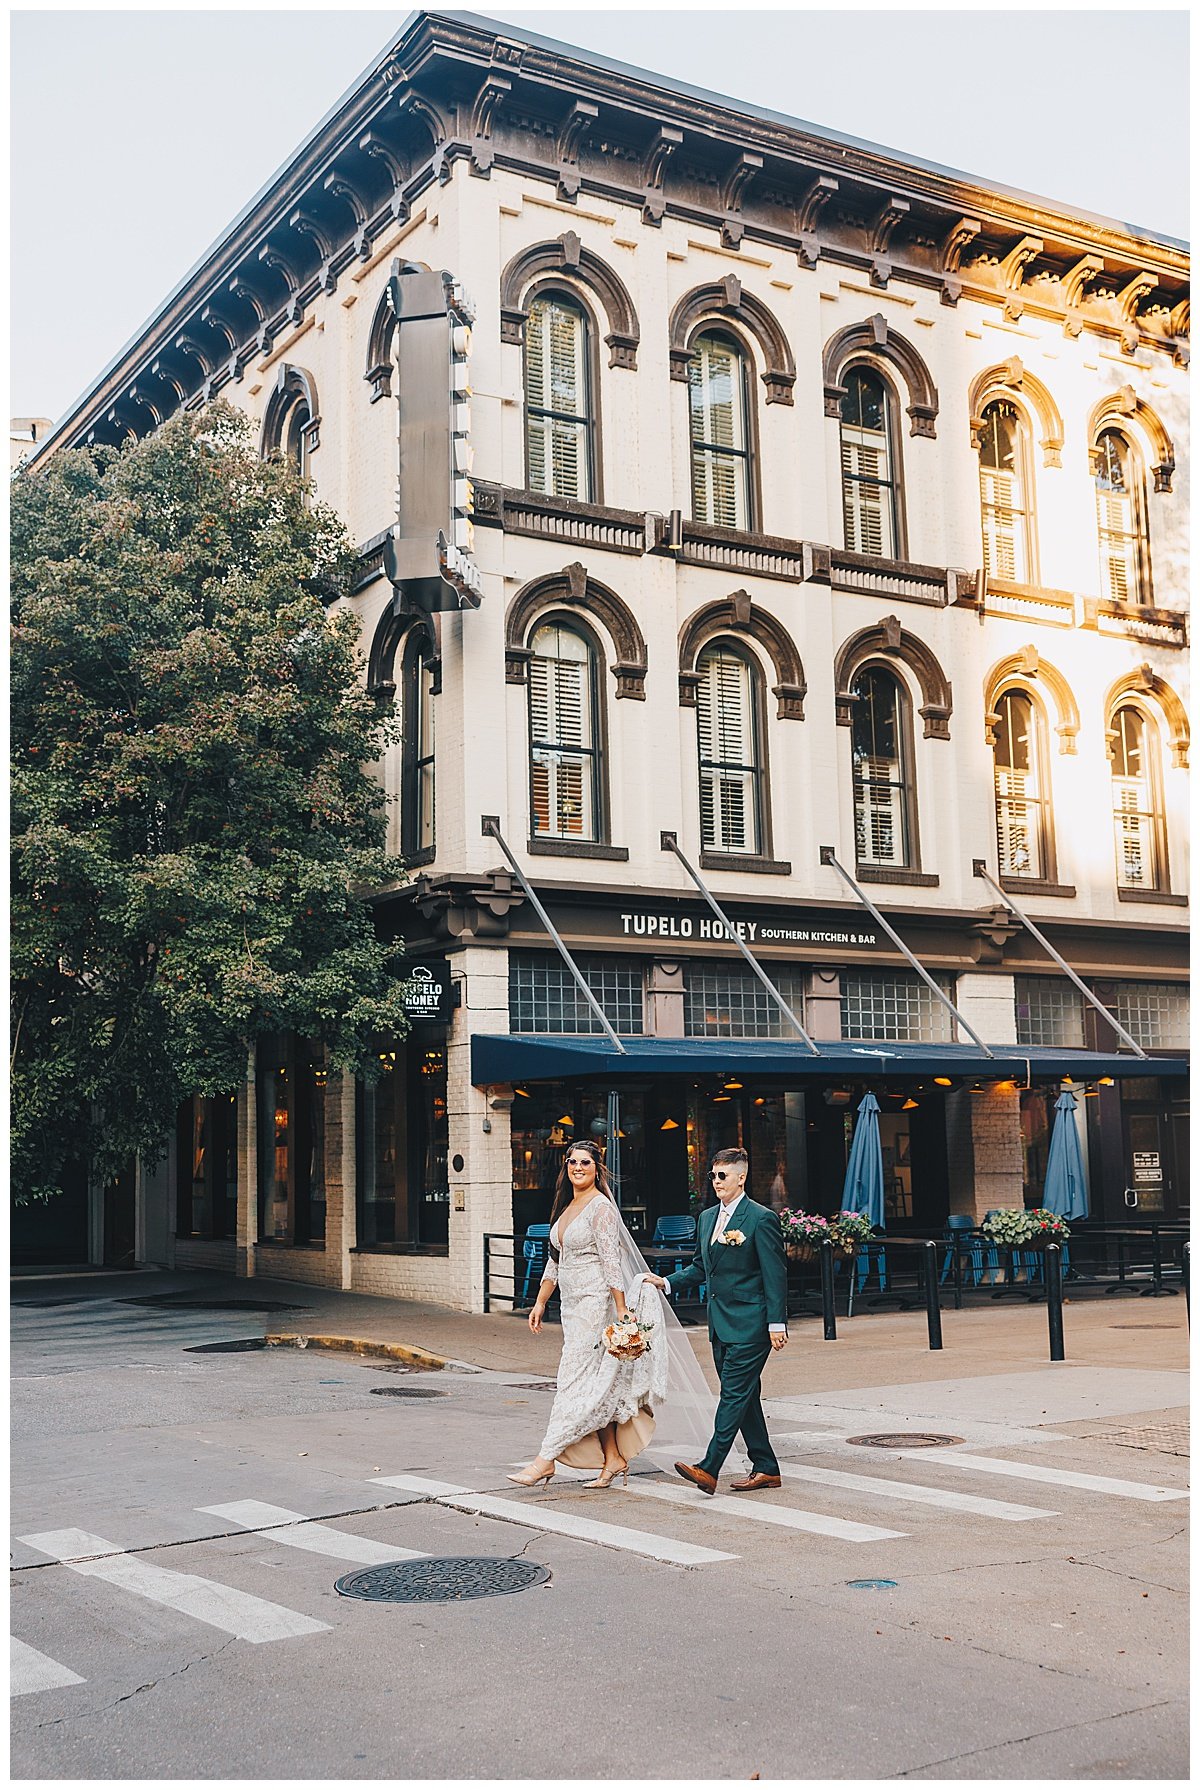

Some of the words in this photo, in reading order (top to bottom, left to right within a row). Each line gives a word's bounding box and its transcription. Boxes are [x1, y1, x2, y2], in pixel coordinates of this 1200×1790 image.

[621, 914, 692, 937] TUPELO
[760, 928, 809, 941] SOUTHERN
[811, 931, 848, 943] KITCHEN
[850, 934, 857, 943] &
[858, 934, 876, 944] BAR
[403, 984, 442, 995] ELO
[405, 995, 440, 1005] HONEY
